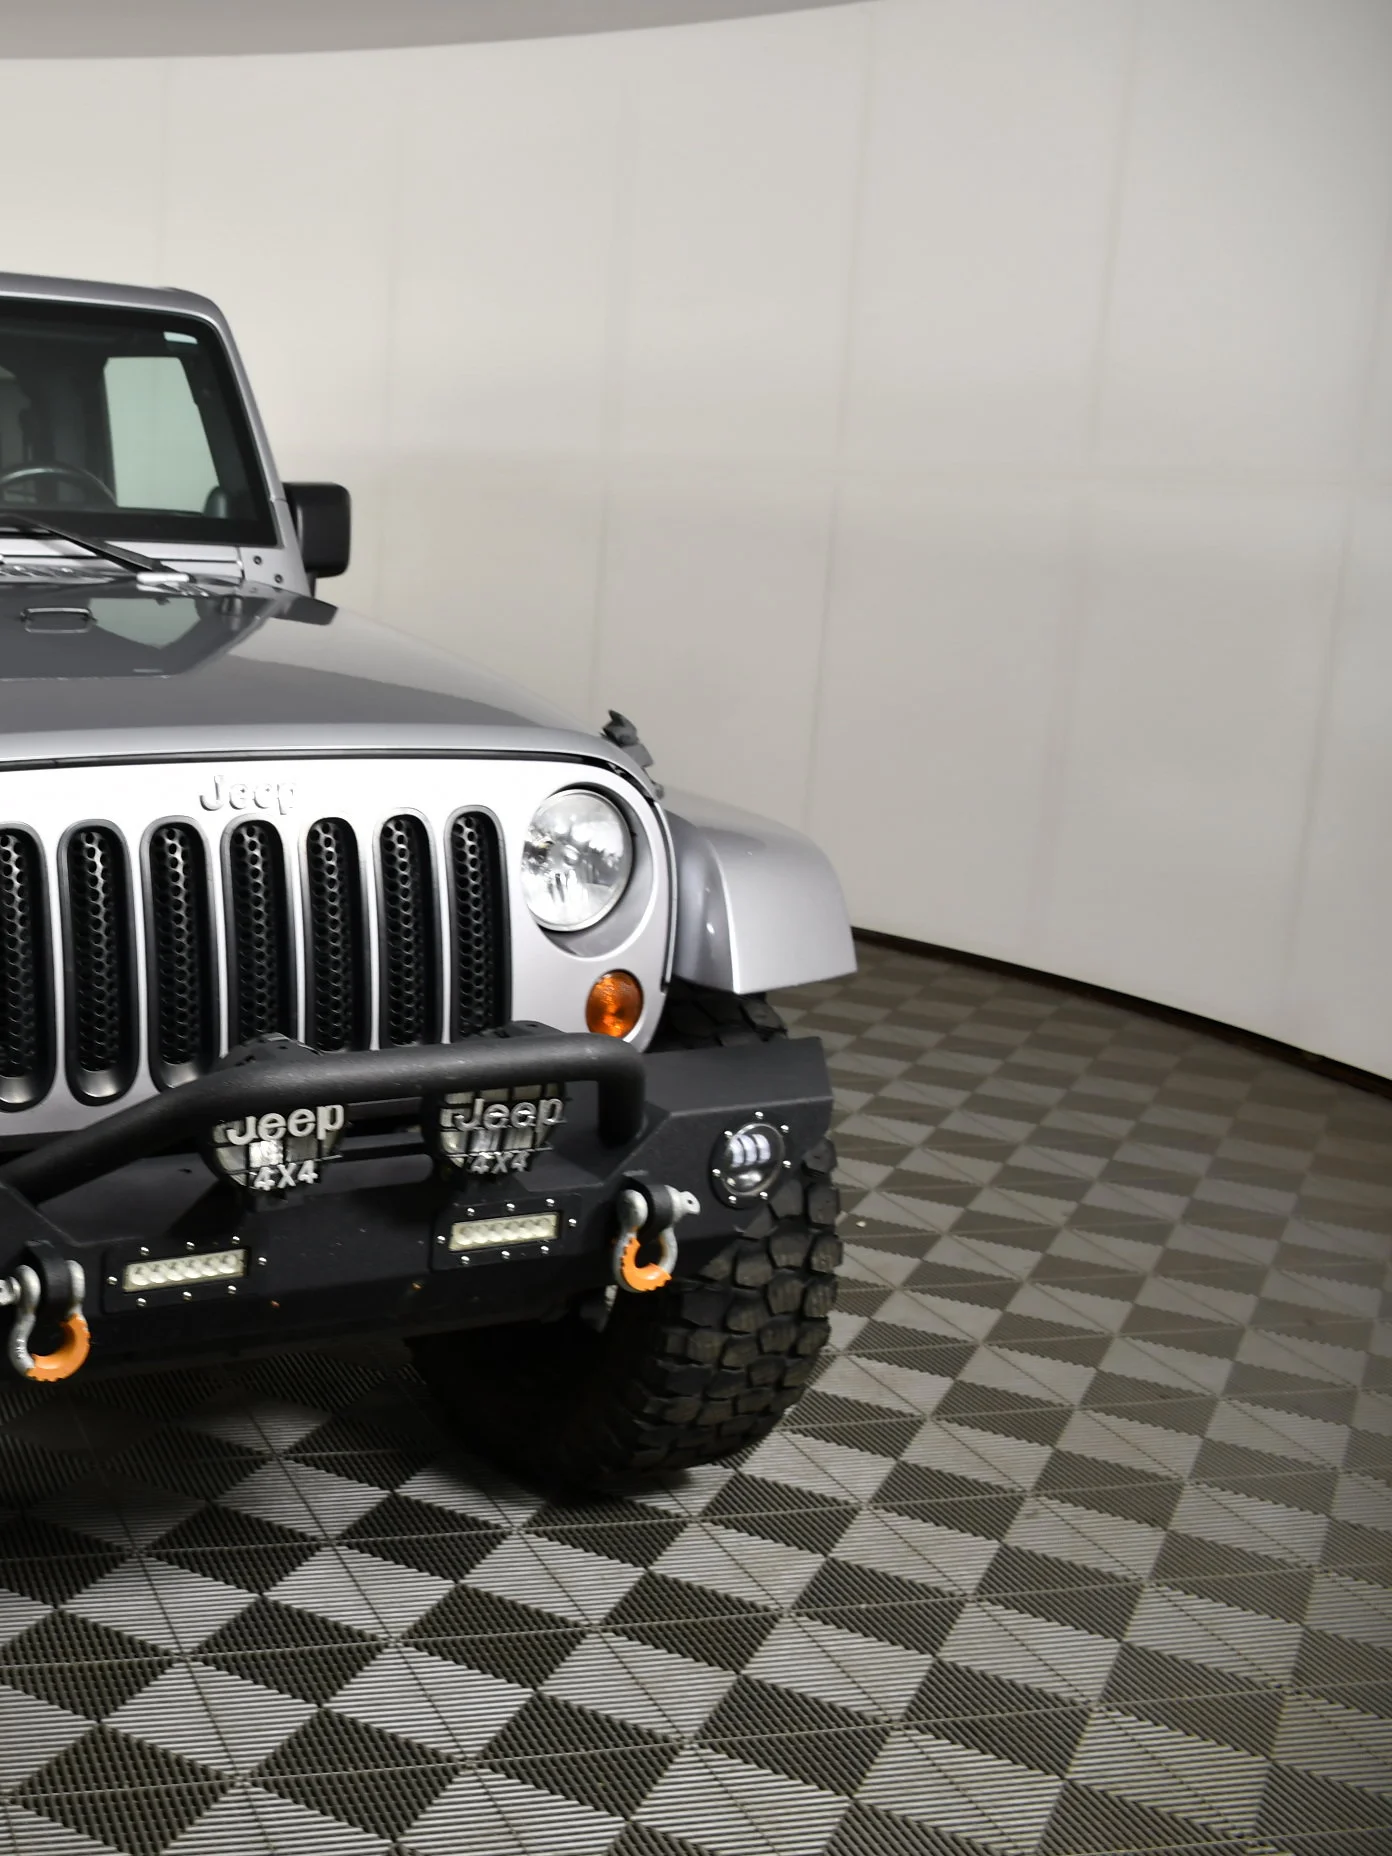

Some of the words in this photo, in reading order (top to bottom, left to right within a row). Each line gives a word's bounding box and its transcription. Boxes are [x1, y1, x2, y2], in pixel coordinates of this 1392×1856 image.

[198, 774, 296, 816] Jeep
[226, 1104, 345, 1146] Jeep
[454, 1098, 564, 1134] Jeep
